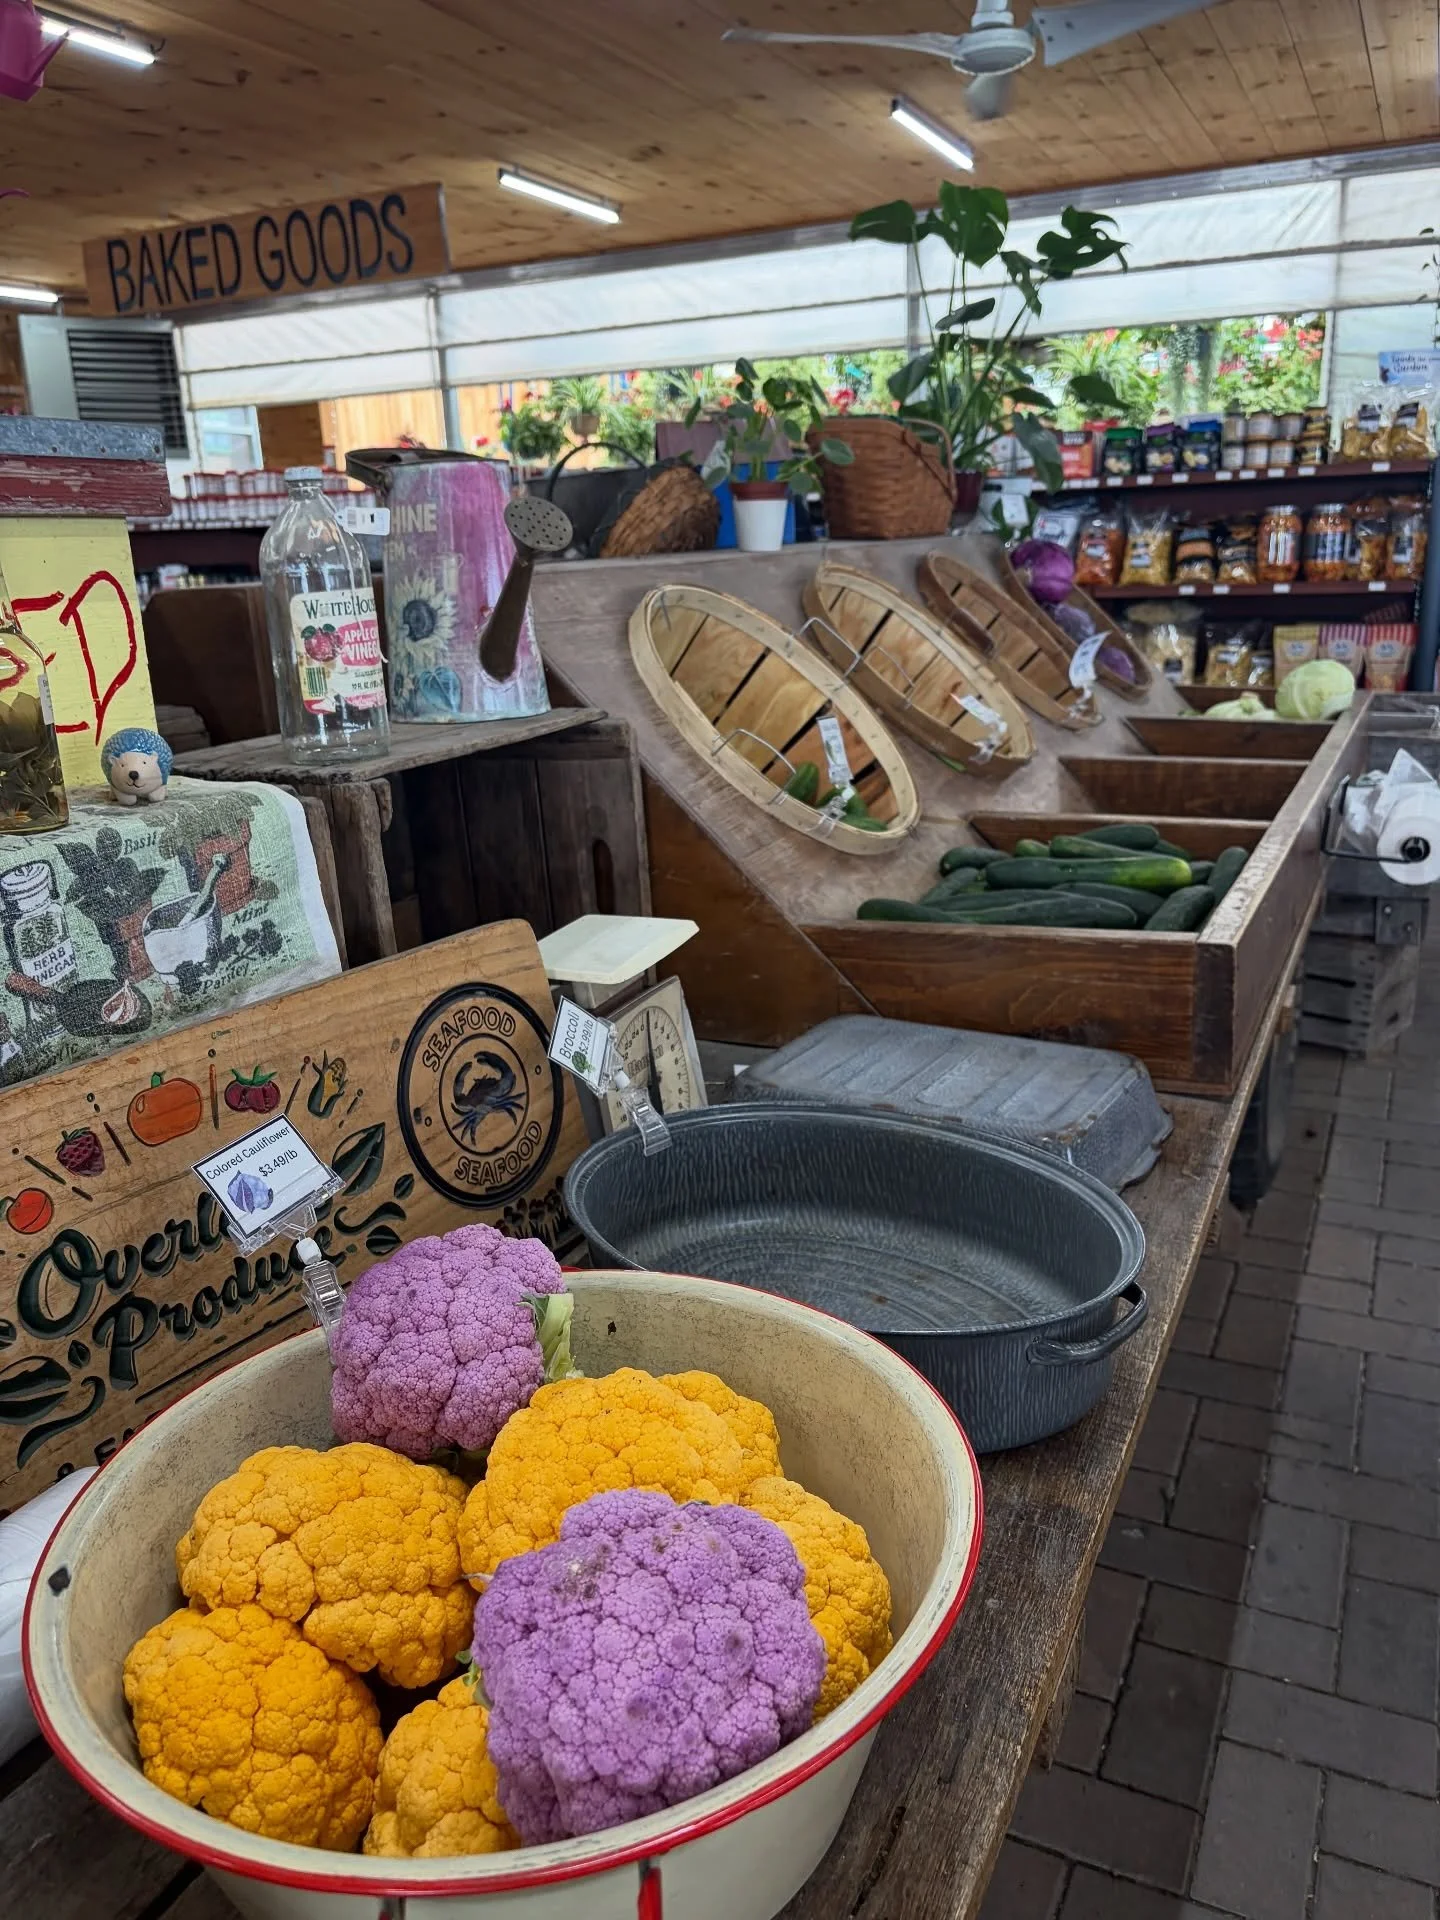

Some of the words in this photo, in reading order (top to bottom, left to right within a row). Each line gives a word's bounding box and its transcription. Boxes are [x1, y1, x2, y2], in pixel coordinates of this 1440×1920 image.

[107, 223, 242, 313] BAKED
[254, 194, 413, 291] GOODS
[124, 831, 157, 855] Basil
[232, 901, 269, 926] Mint
[33, 946, 66, 971] HERB
[422, 1006, 516, 1073] SEAFOOD
[559, 1010, 580, 1059] Broccoli
[579, 1019, 594, 1055] $2.99/lb
[206, 1154, 243, 1180] Colored
[242, 1126, 290, 1159] Cauliflower
[259, 1150, 298, 1177] $3.49/lb
[454, 1120, 542, 1186] SEAFOOD
[17, 1191, 333, 1340] Overl
